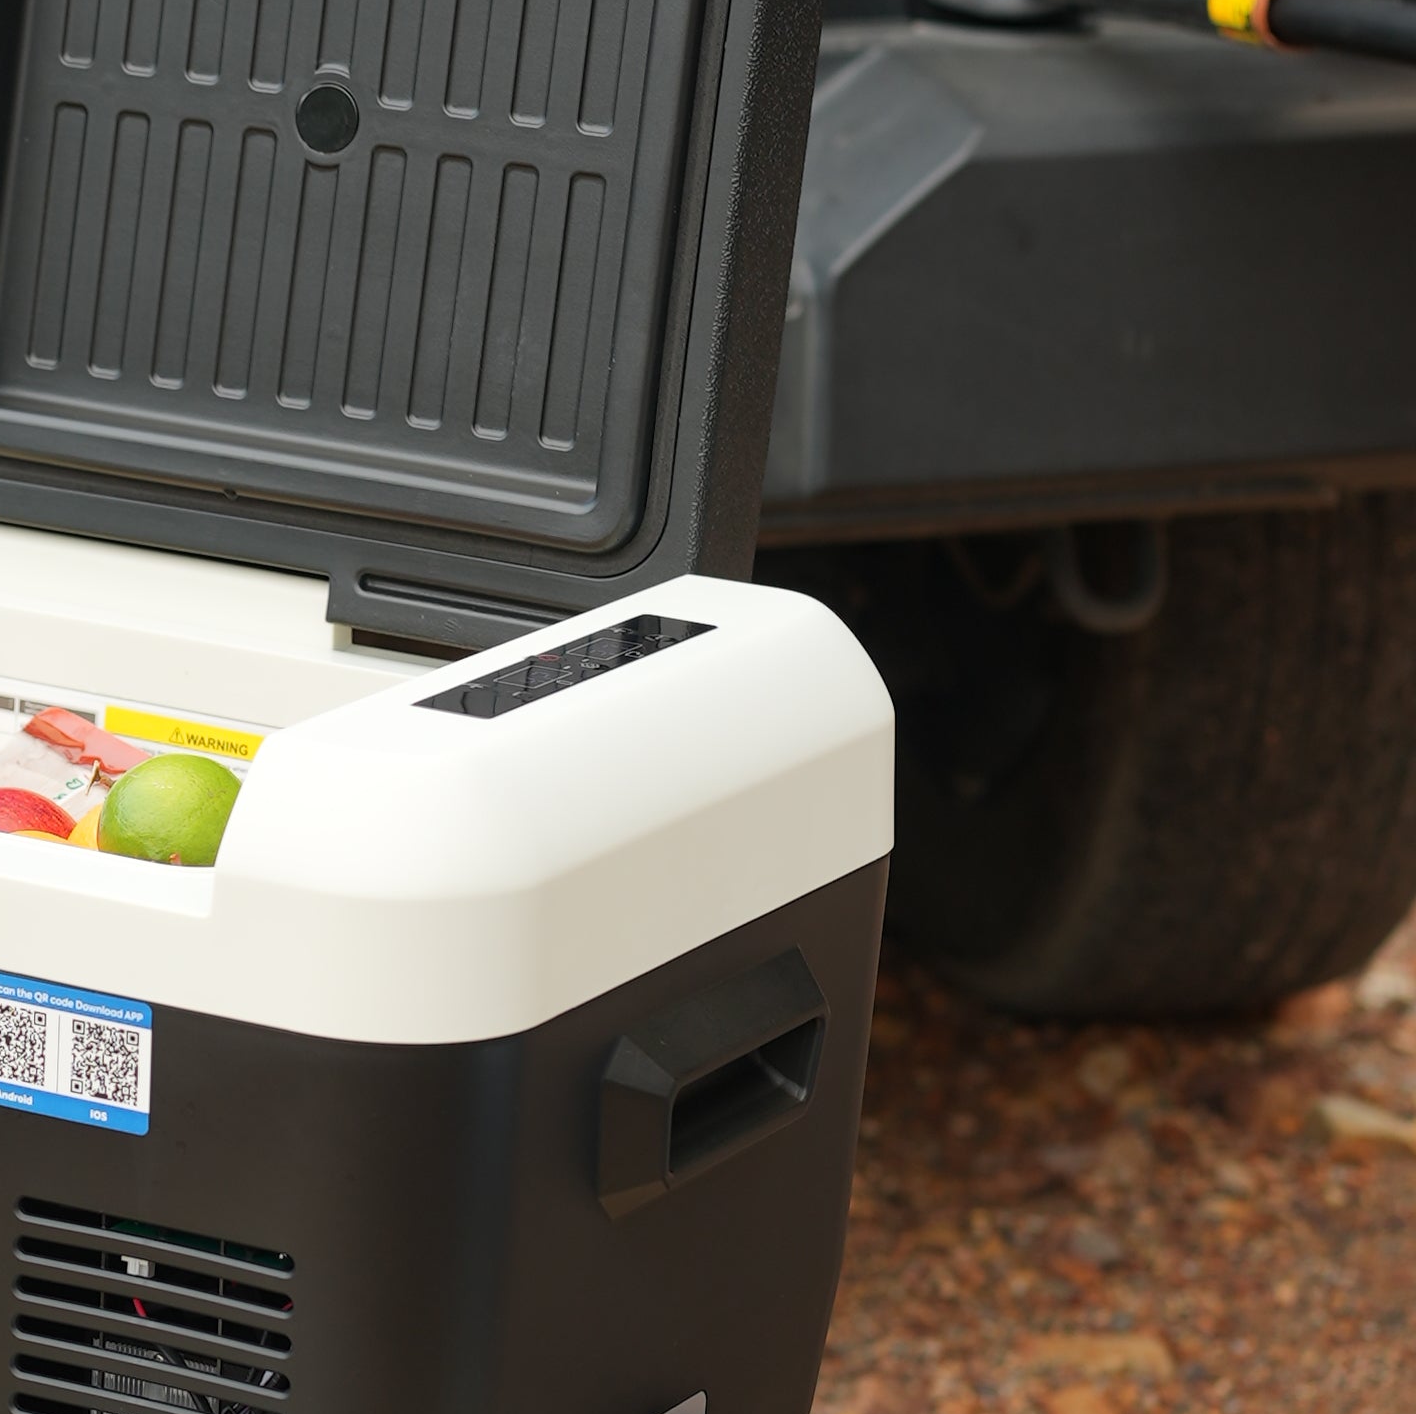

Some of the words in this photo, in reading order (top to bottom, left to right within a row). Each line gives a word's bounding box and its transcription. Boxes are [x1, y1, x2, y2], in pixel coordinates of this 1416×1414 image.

[186, 733, 249, 756] WARNING
[16, 987, 33, 1000] the
[34, 991, 49, 1003] QR
[49, 996, 74, 1008] code
[75, 999, 124, 1019] Download
[124, 1010, 144, 1022] APP
